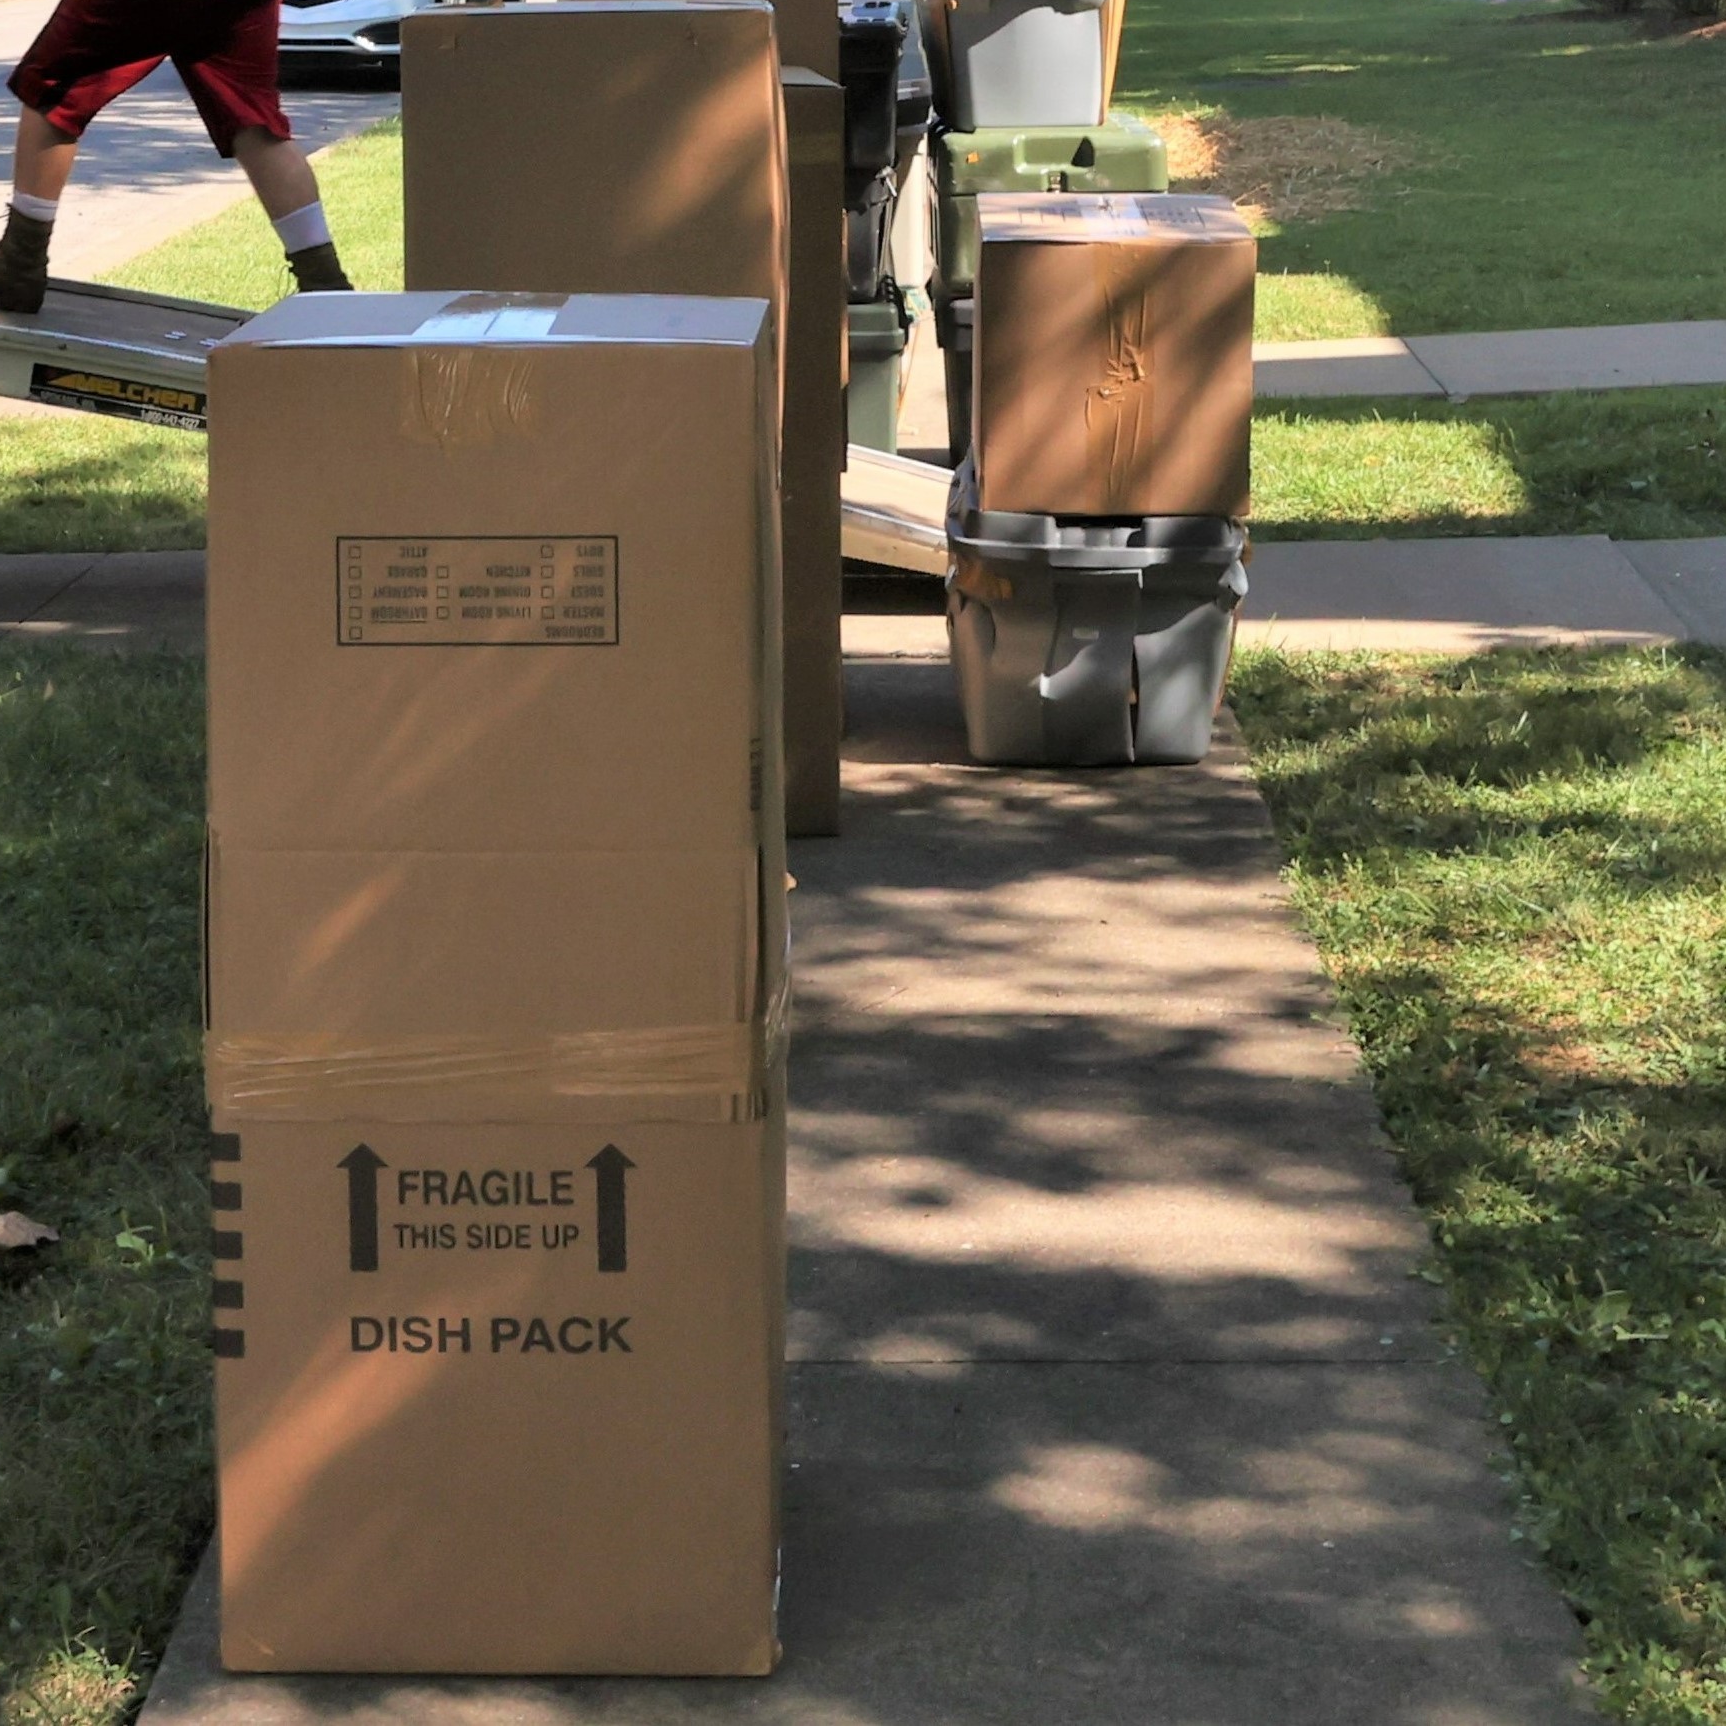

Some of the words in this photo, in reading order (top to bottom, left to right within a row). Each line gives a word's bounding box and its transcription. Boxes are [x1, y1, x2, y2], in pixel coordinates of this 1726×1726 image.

[397, 1169, 575, 1206] FRAGILE
[394, 1223, 456, 1250] THIS
[467, 1223, 532, 1250] SIDE
[541, 1223, 579, 1250] UP
[350, 1315, 472, 1353] DISH
[489, 1315, 633, 1353] PACK
